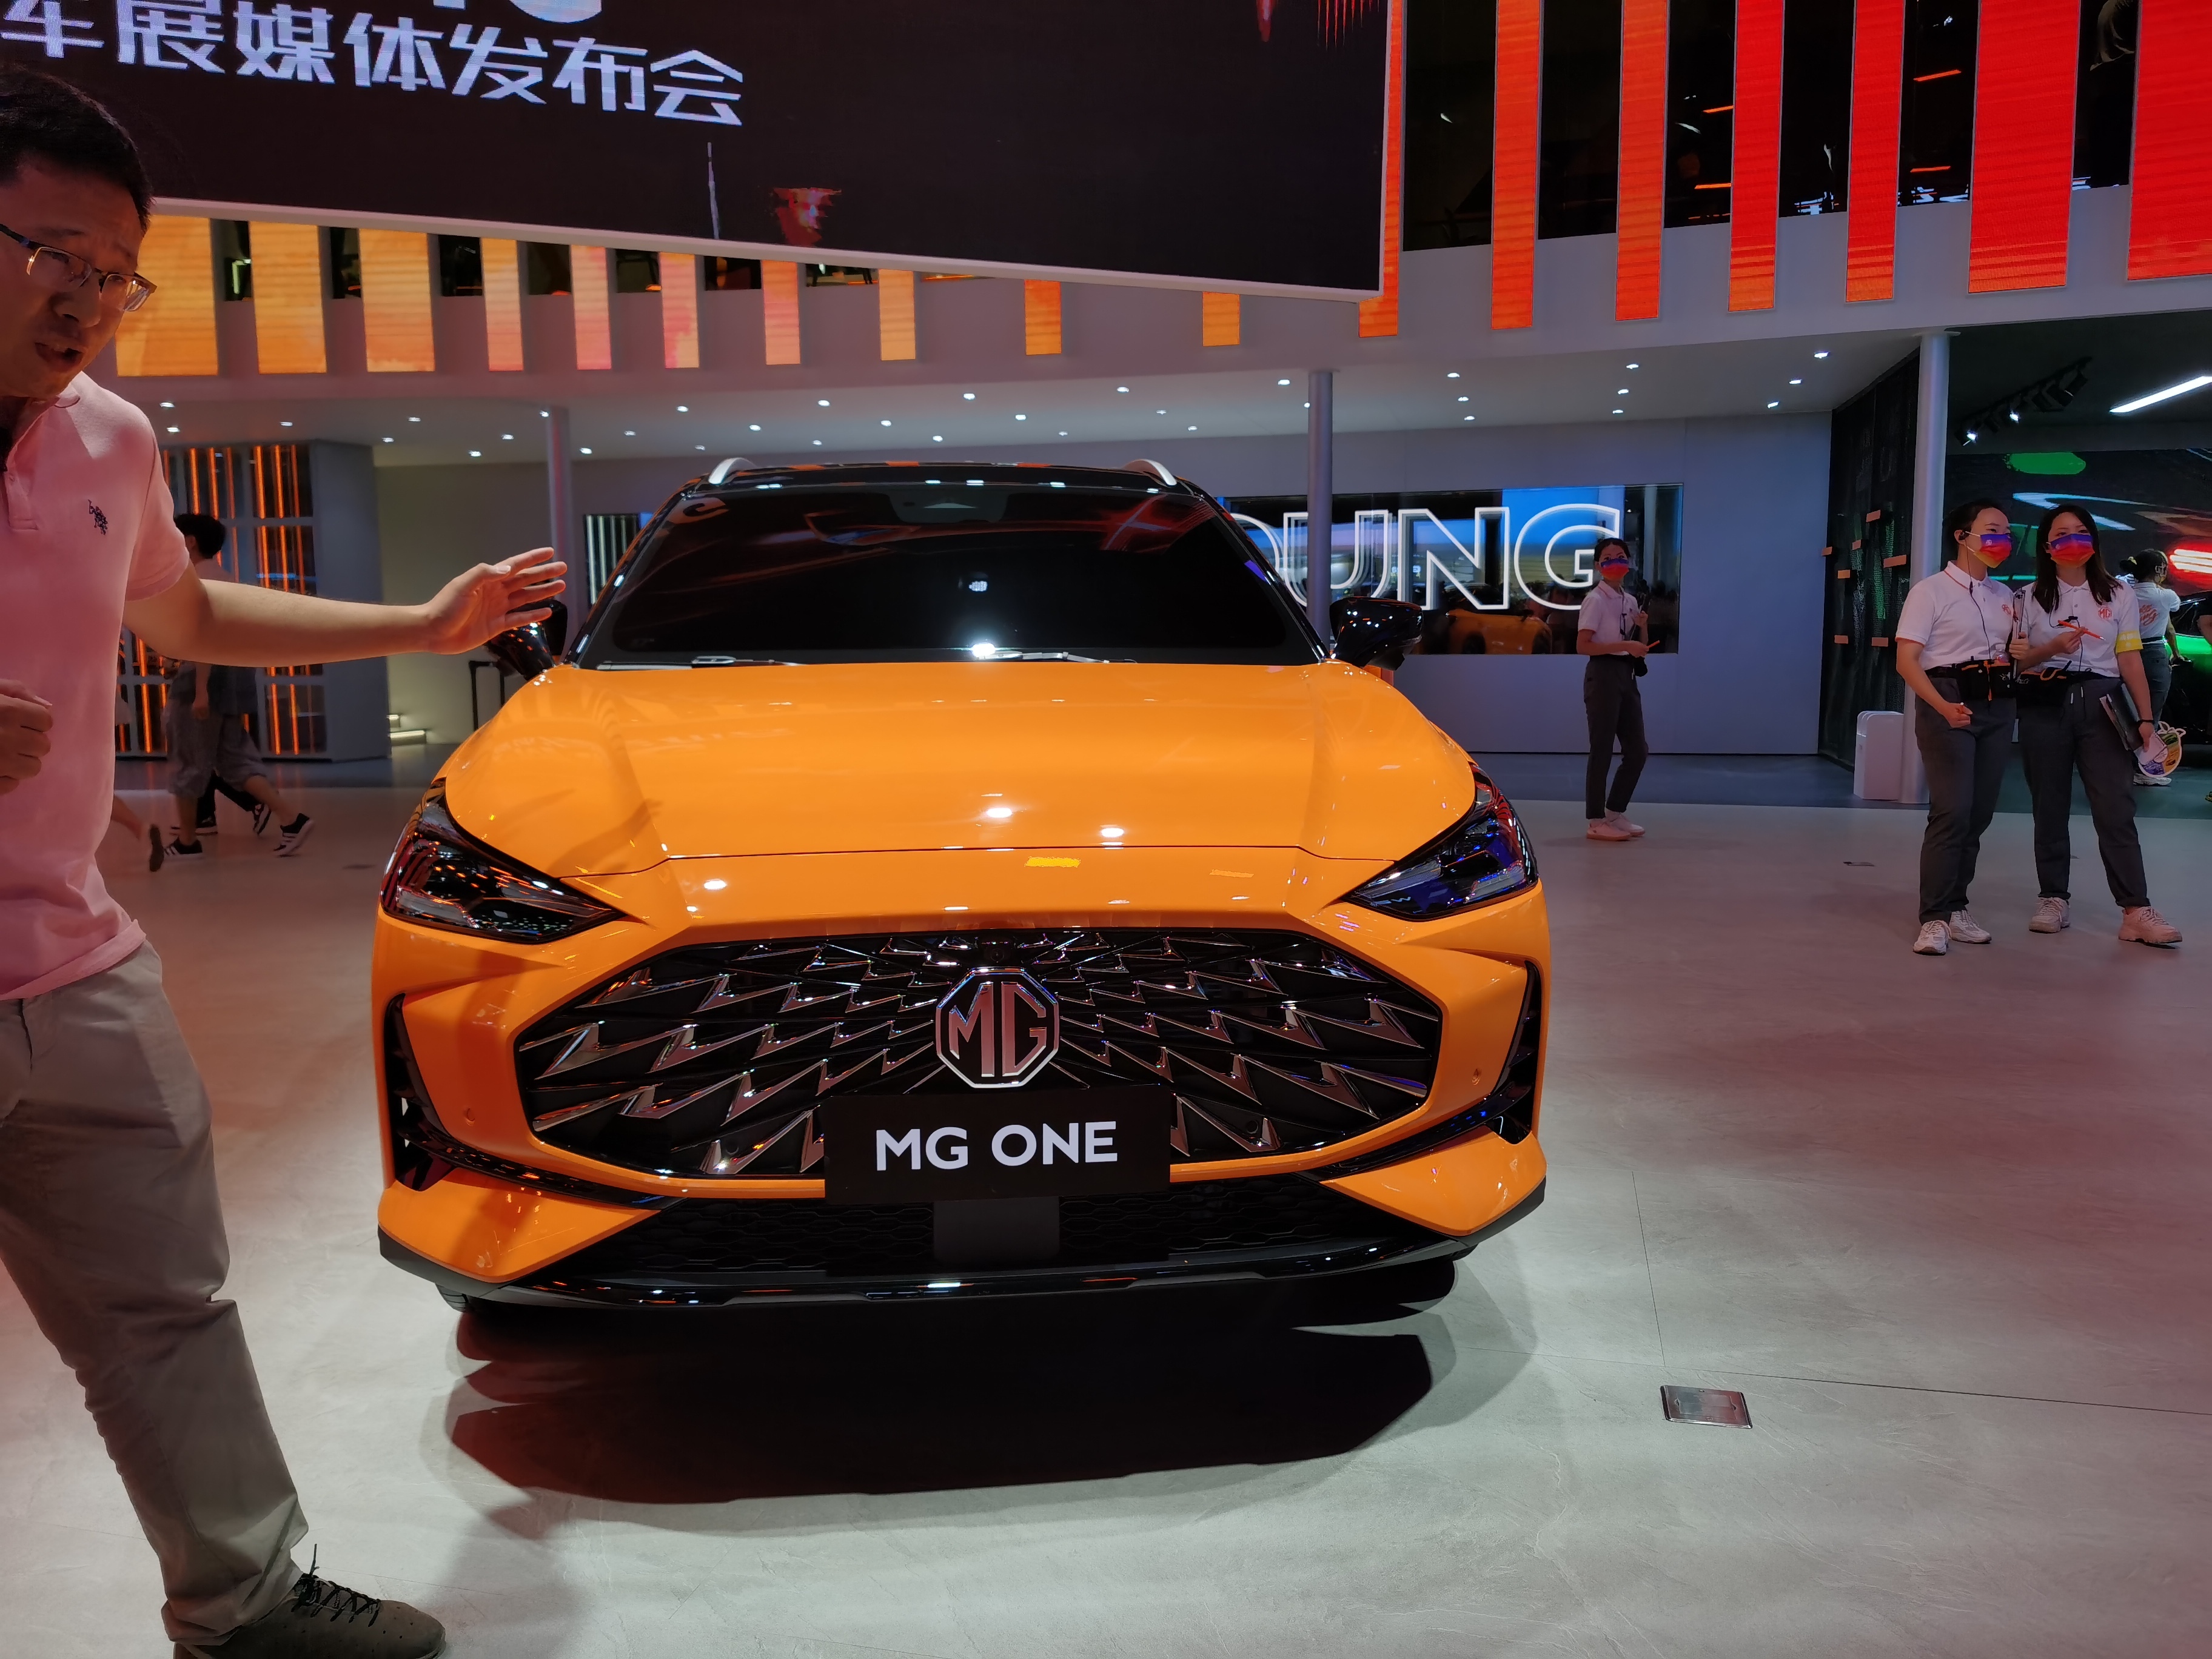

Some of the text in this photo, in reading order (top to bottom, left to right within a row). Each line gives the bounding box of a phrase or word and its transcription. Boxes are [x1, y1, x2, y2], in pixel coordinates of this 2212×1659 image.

[1230, 503, 1620, 611] UNG
[948, 980, 1047, 1078] MG
[876, 1121, 1118, 1171] MG ONE
